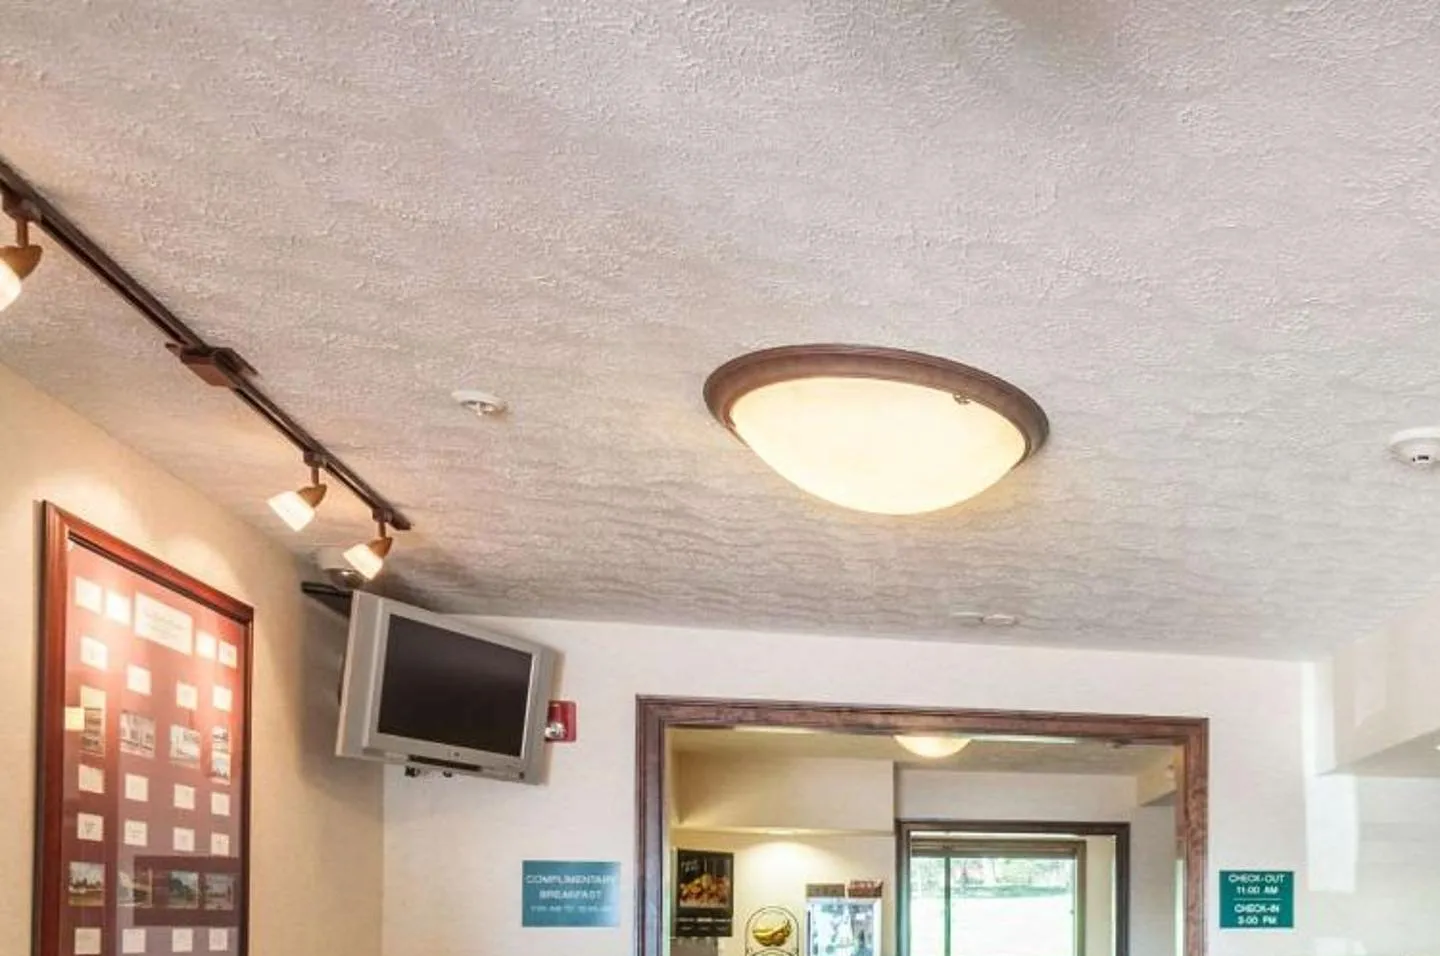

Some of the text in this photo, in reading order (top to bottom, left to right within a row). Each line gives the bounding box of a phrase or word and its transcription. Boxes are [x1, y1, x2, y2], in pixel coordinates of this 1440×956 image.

[1228, 873, 1285, 883] CHECK-OUT
[1264, 886, 1279, 894] AM
[1234, 904, 1280, 913] CHECK-IN
[1262, 915, 1277, 924] PM
